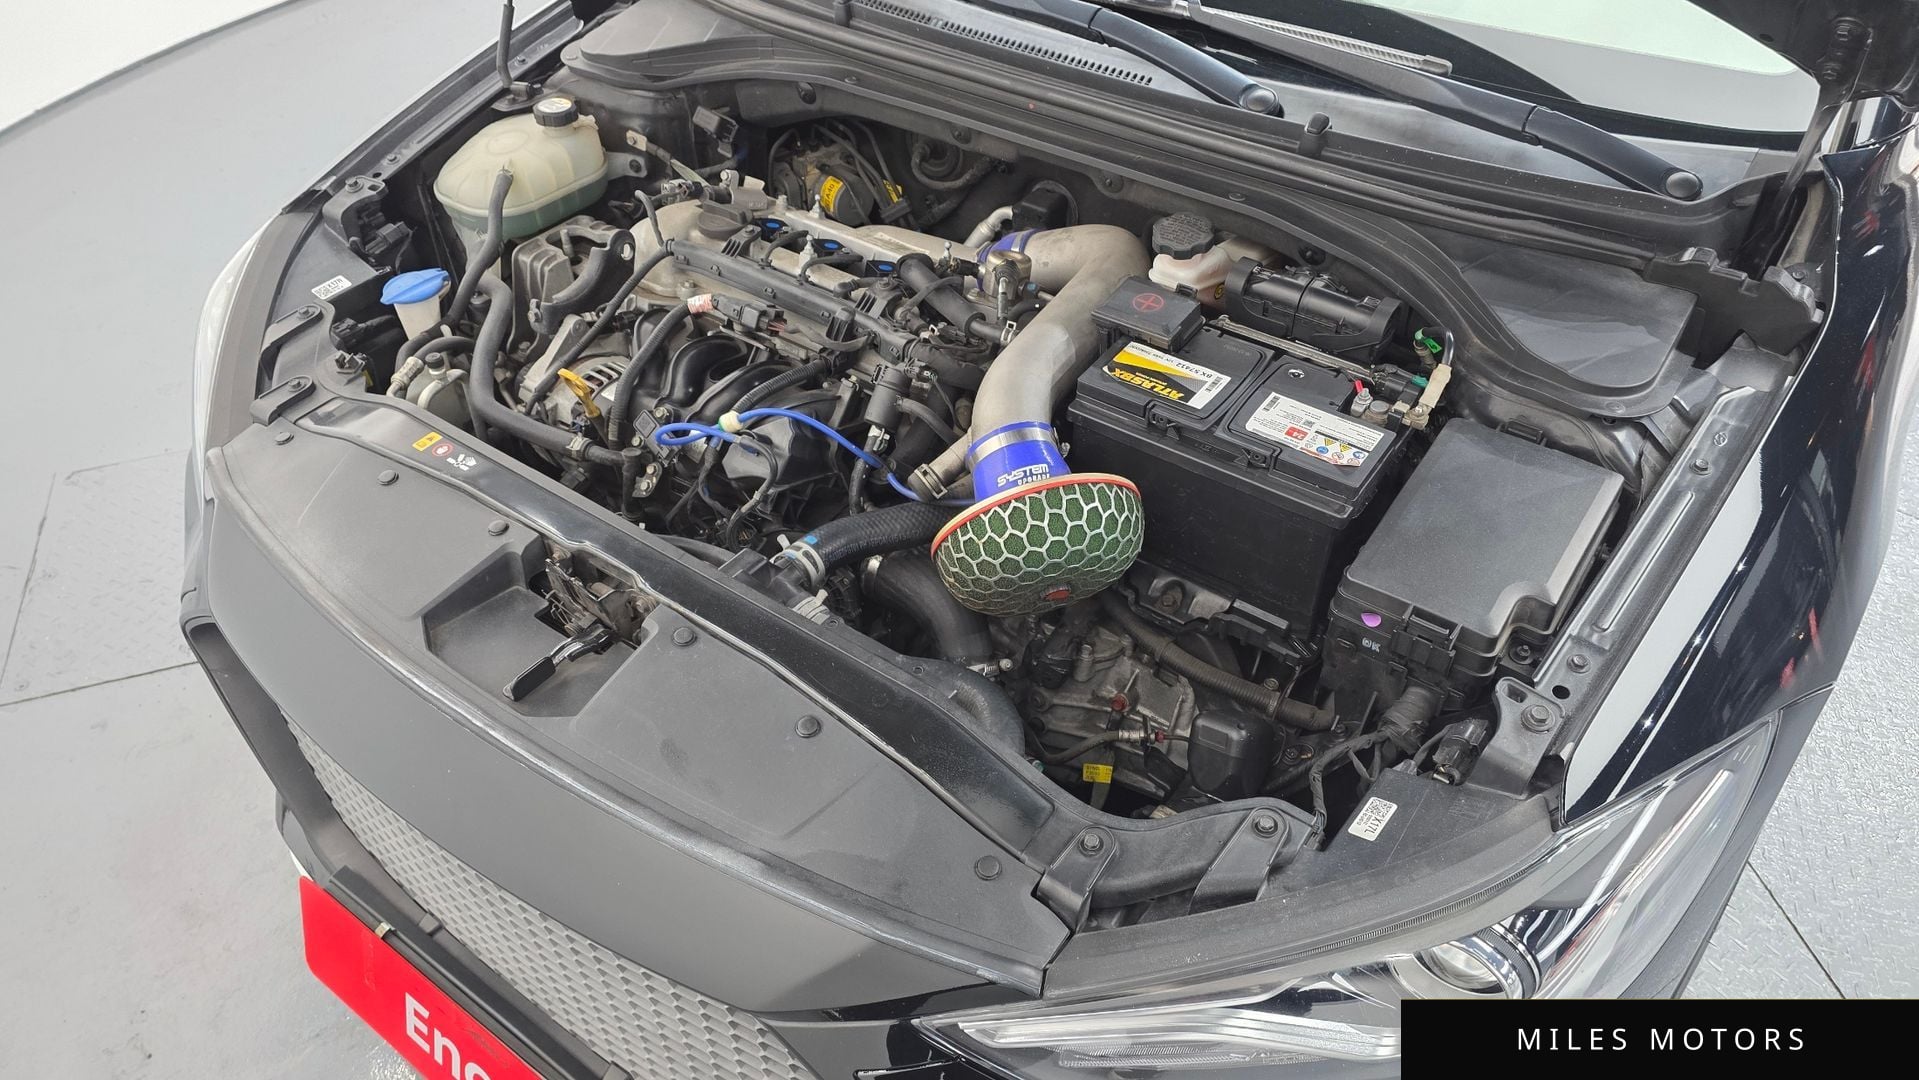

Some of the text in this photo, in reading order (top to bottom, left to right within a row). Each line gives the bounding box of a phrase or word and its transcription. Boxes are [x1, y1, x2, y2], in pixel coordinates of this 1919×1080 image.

[1110, 367, 1185, 401] ATLASBX
[1200, 371, 1213, 379] BX
[1291, 430, 1306, 440] 24
[997, 463, 1050, 488] SYSTEM
[1364, 816, 1383, 834] X17L
